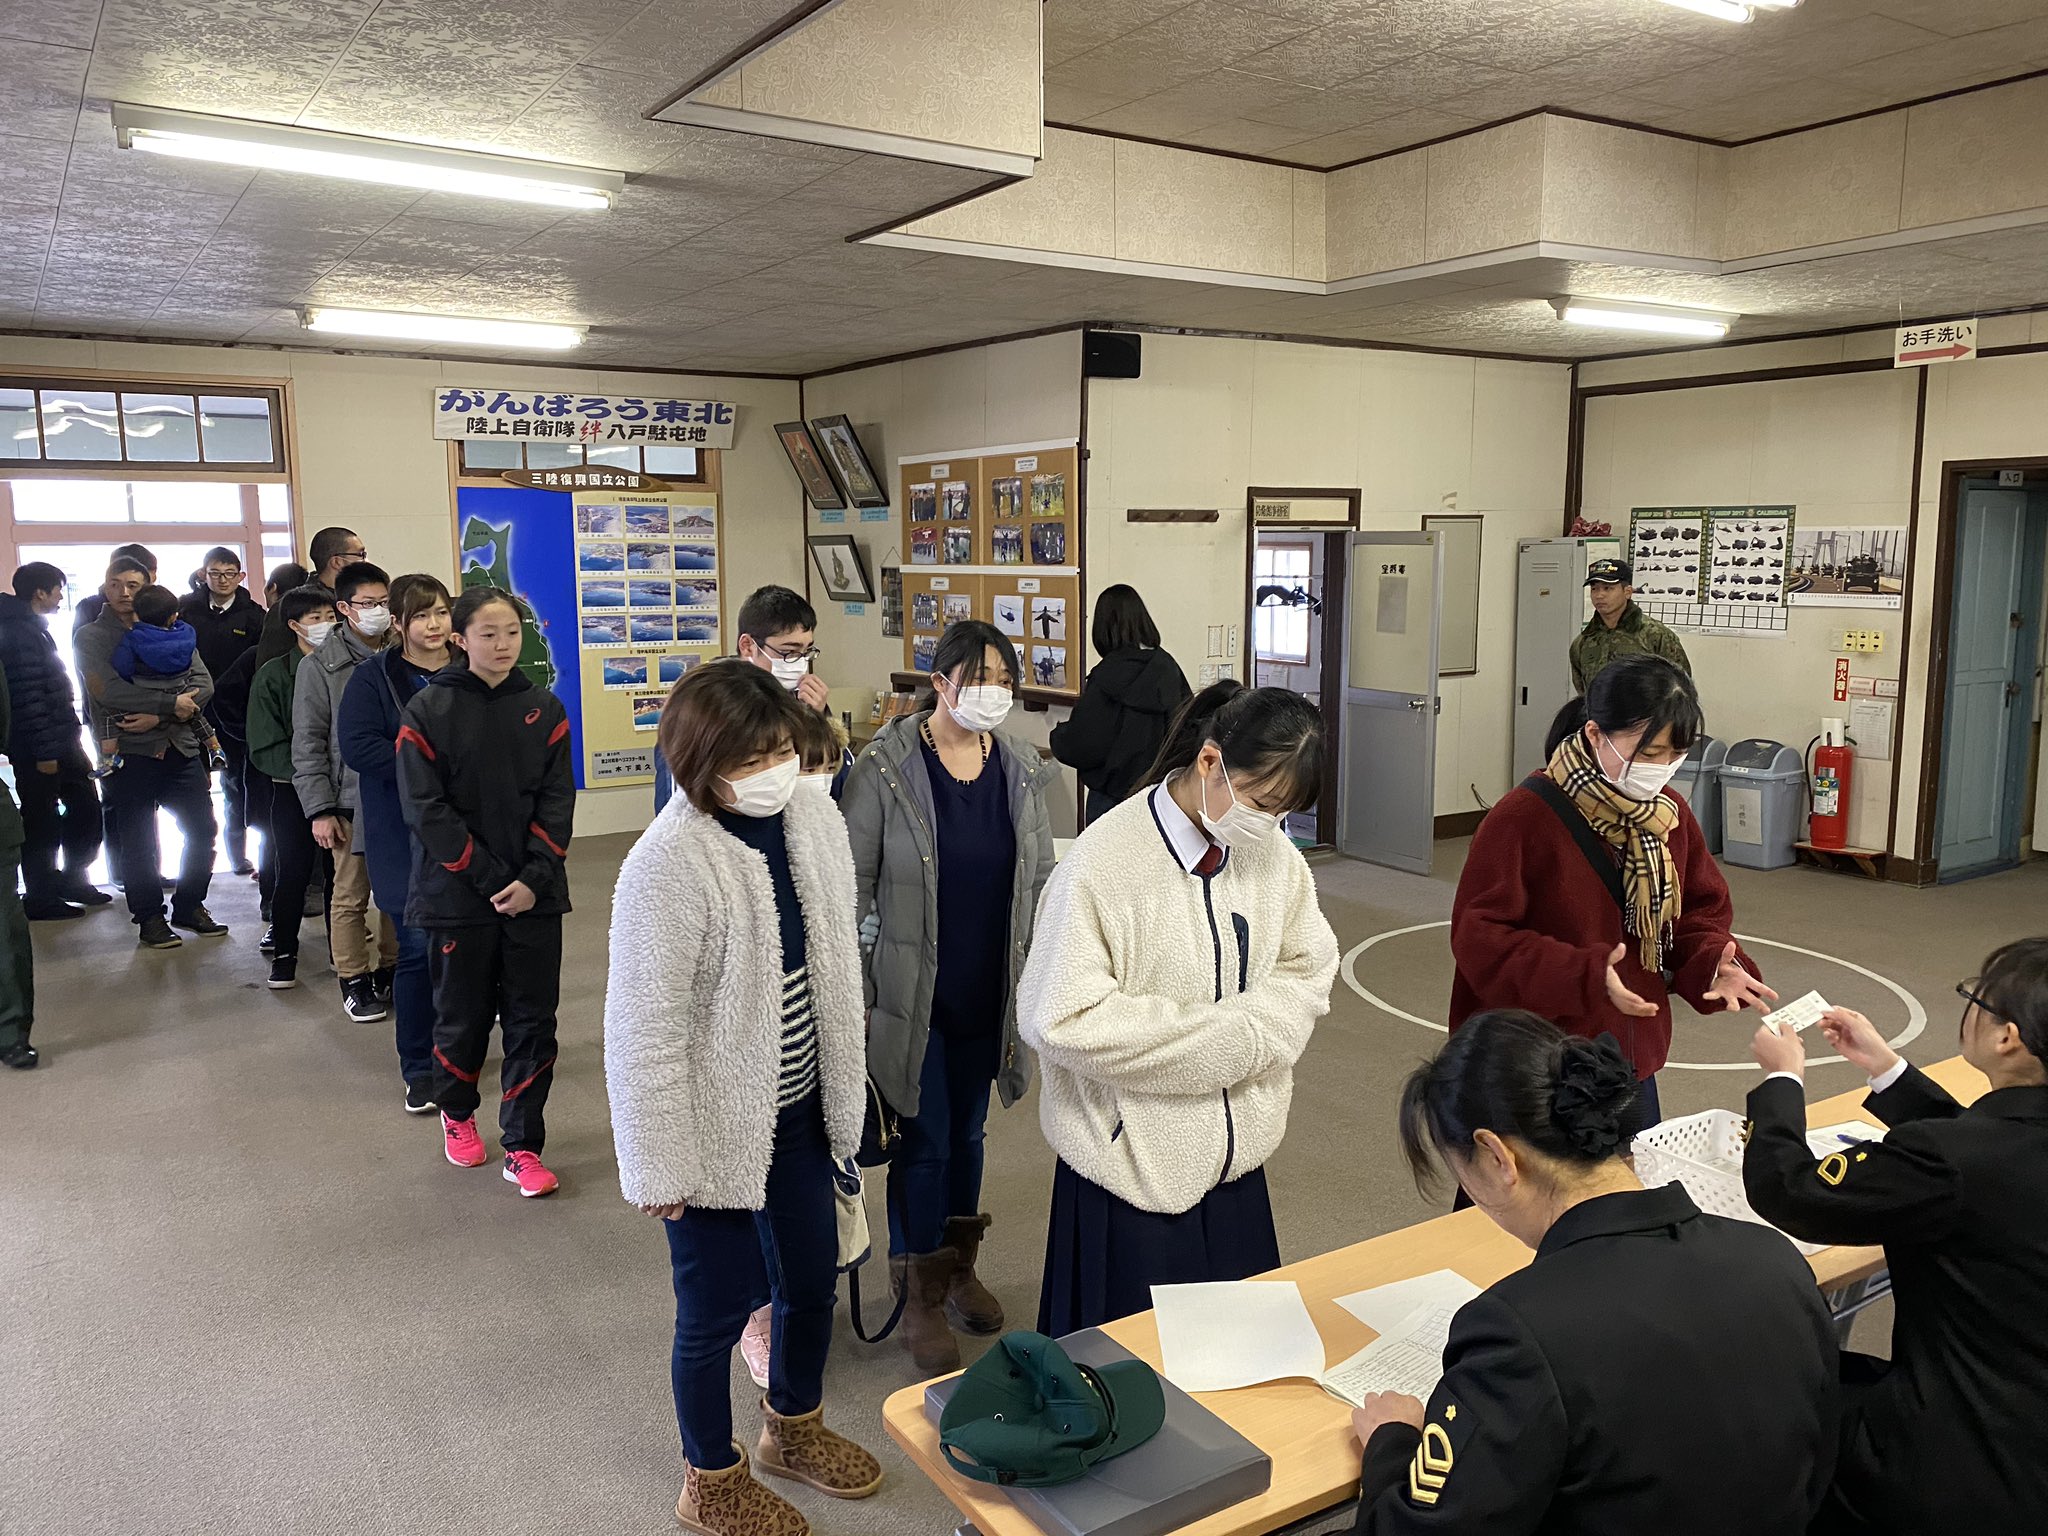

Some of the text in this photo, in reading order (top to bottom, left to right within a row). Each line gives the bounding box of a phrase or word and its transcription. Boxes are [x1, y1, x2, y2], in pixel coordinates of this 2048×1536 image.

[1902, 325, 1973, 347] お手洗い
[438, 389, 733, 425] がんばろう東北
[466, 416, 707, 443] 陸上自衛隊 絆 八戸駐屯地
[531, 472, 640, 488] 三陸復興国立公園
[1836, 660, 1848, 691] 消火器
